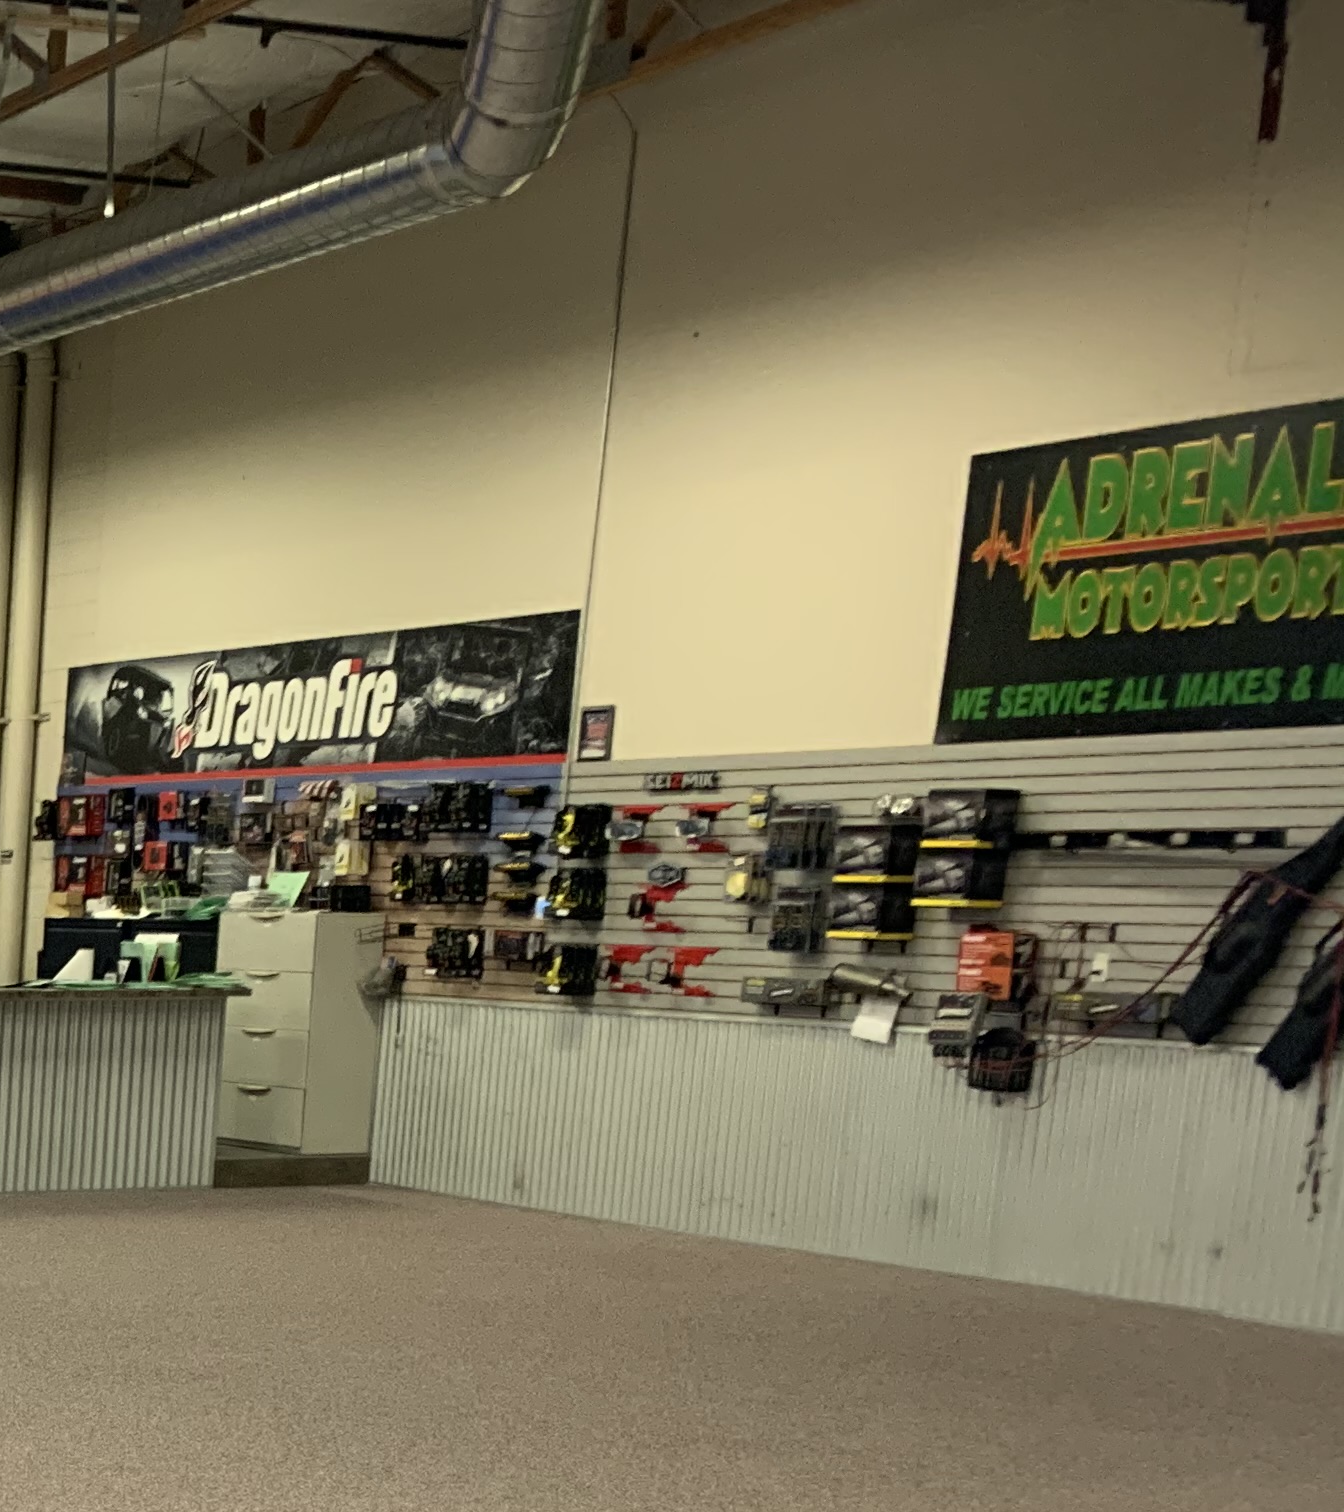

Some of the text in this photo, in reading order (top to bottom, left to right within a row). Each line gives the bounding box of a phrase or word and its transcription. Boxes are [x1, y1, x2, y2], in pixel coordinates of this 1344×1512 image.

[952, 686, 994, 721] WE
[997, 678, 1114, 719] SERVICE
[1114, 674, 1167, 712] ALL
[1175, 667, 1284, 709] MAKES
[1290, 664, 1312, 701] &
